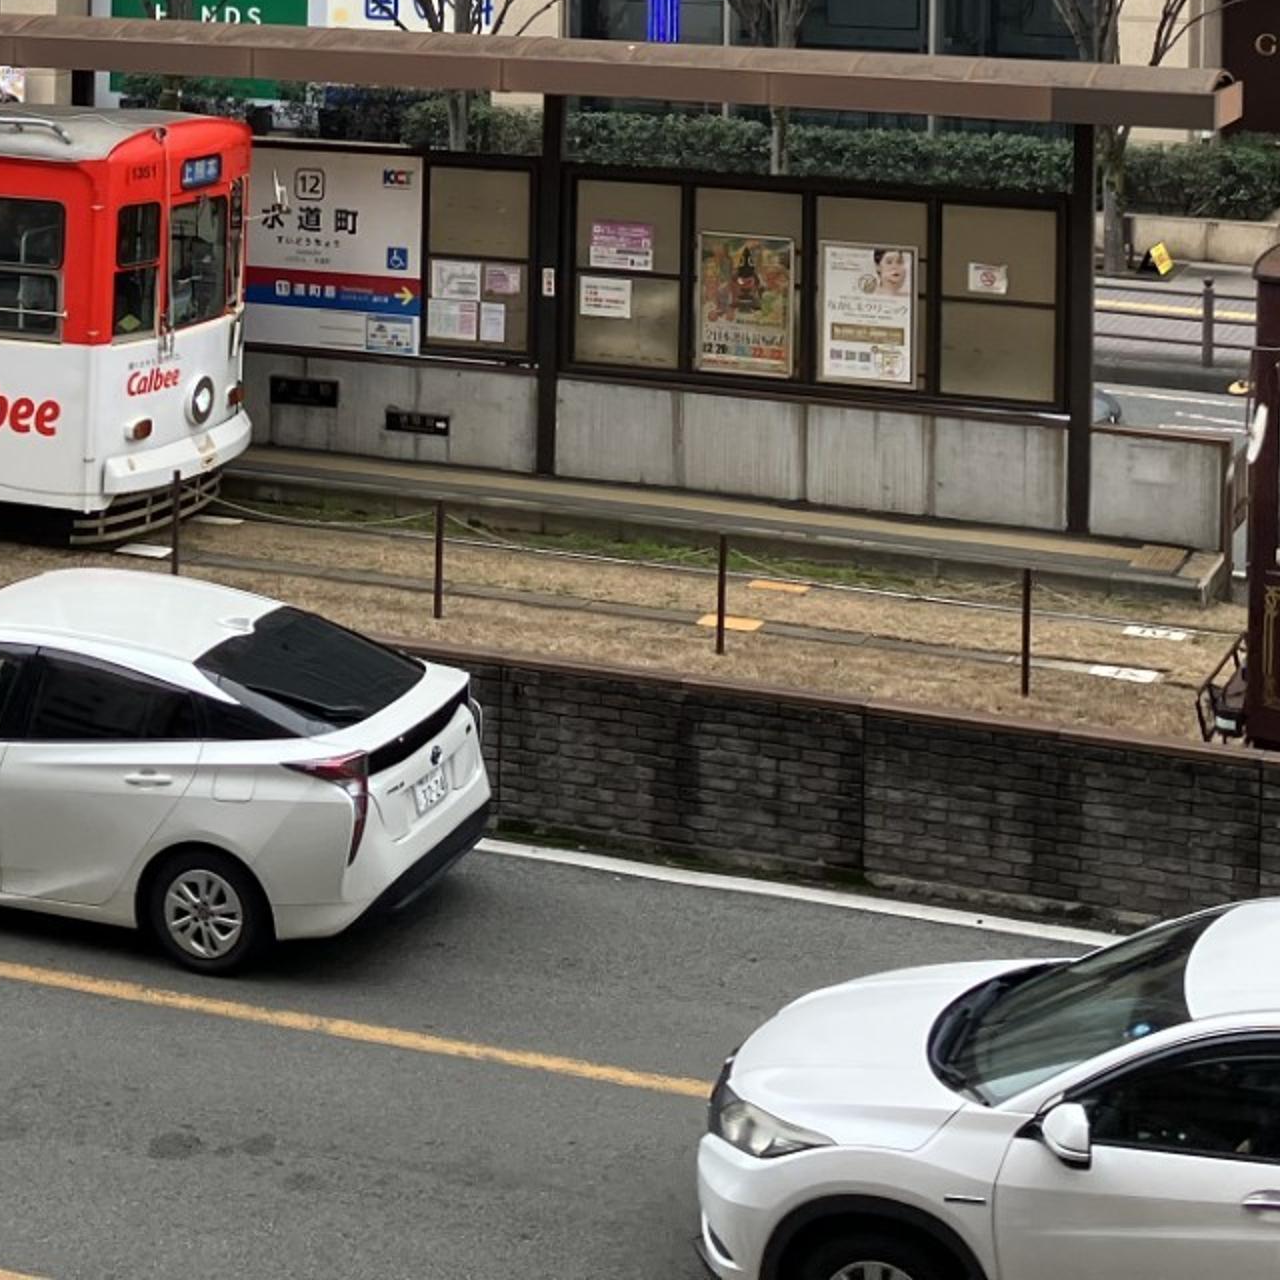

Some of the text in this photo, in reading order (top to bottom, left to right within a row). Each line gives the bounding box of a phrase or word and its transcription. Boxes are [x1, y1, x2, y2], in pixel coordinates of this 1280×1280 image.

[155, 3, 261, 25] HNDS
[299, 175, 320, 194] 12
[383, 168, 413, 186] KCT
[261, 203, 359, 235] 水道町
[127, 367, 180, 396] Calbee
